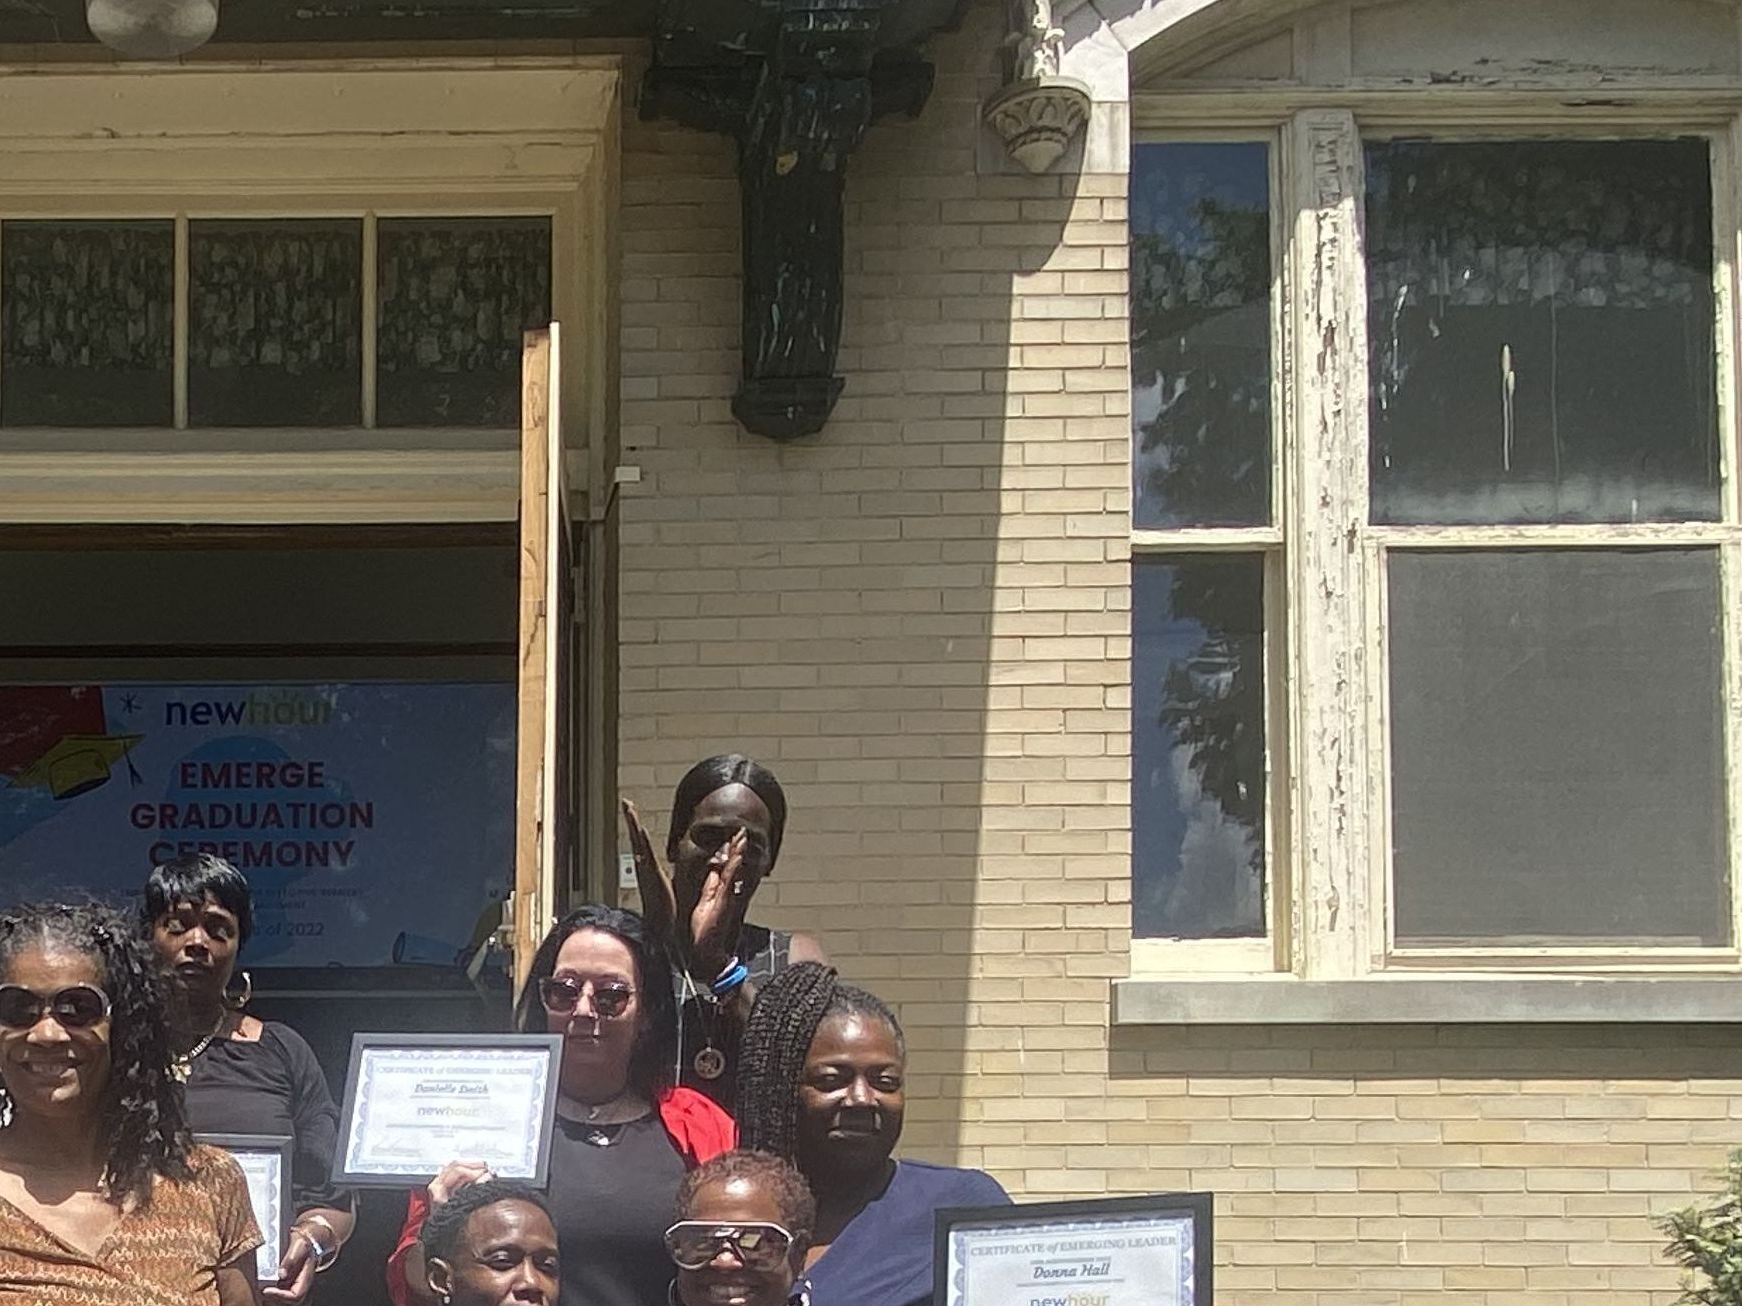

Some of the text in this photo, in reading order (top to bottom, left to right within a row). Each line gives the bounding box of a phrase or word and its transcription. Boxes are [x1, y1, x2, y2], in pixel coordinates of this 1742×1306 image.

[165, 692, 331, 726] newhour
[181, 762, 324, 788] EMERGE
[130, 802, 373, 829] GRADUATION
[287, 922, 324, 936] 2022
[971, 1237, 1176, 1257] CERTIFICATE of EMERGING LEADER
[1033, 1261, 1111, 1279] Donna Hall
